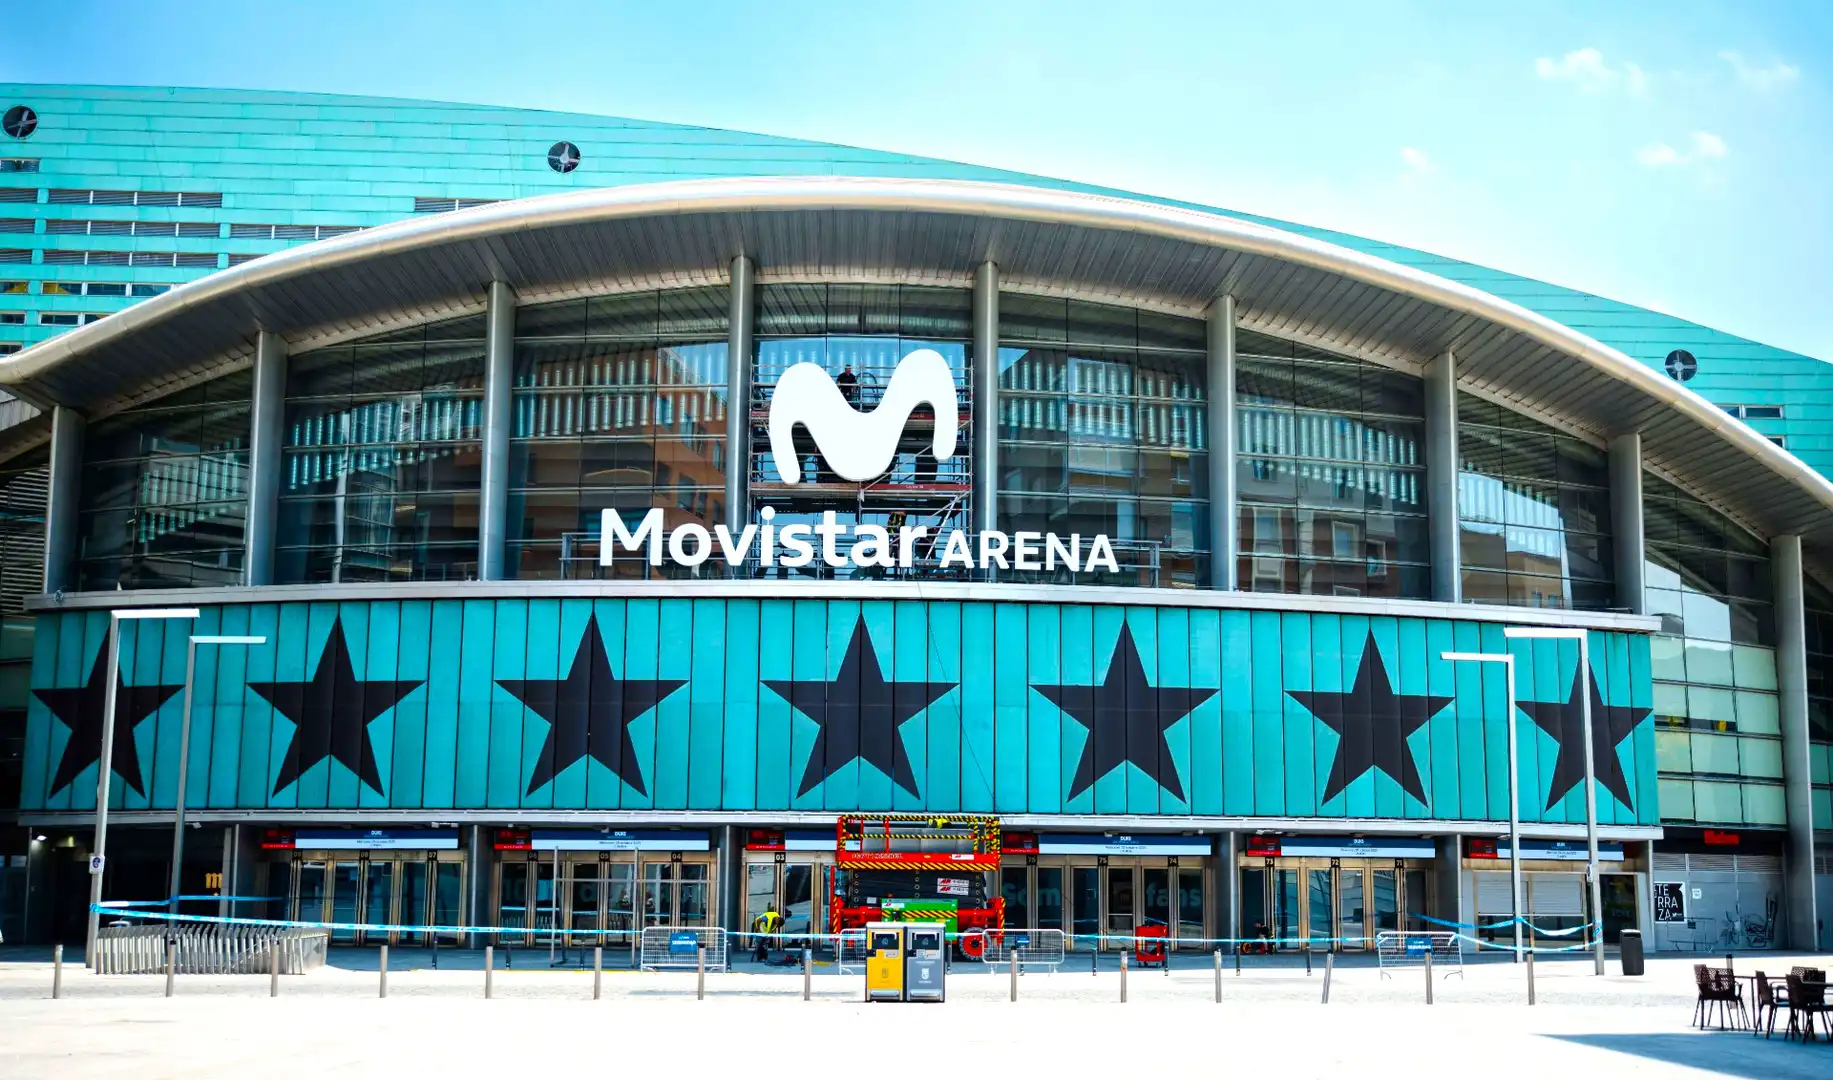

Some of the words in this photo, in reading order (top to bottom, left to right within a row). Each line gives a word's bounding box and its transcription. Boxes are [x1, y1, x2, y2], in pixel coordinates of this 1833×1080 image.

[599, 506, 928, 569] Movistar
[940, 531, 1120, 573] ARENA
[1657, 896, 1679, 908] RRA
[1658, 908, 1672, 921] ZA
